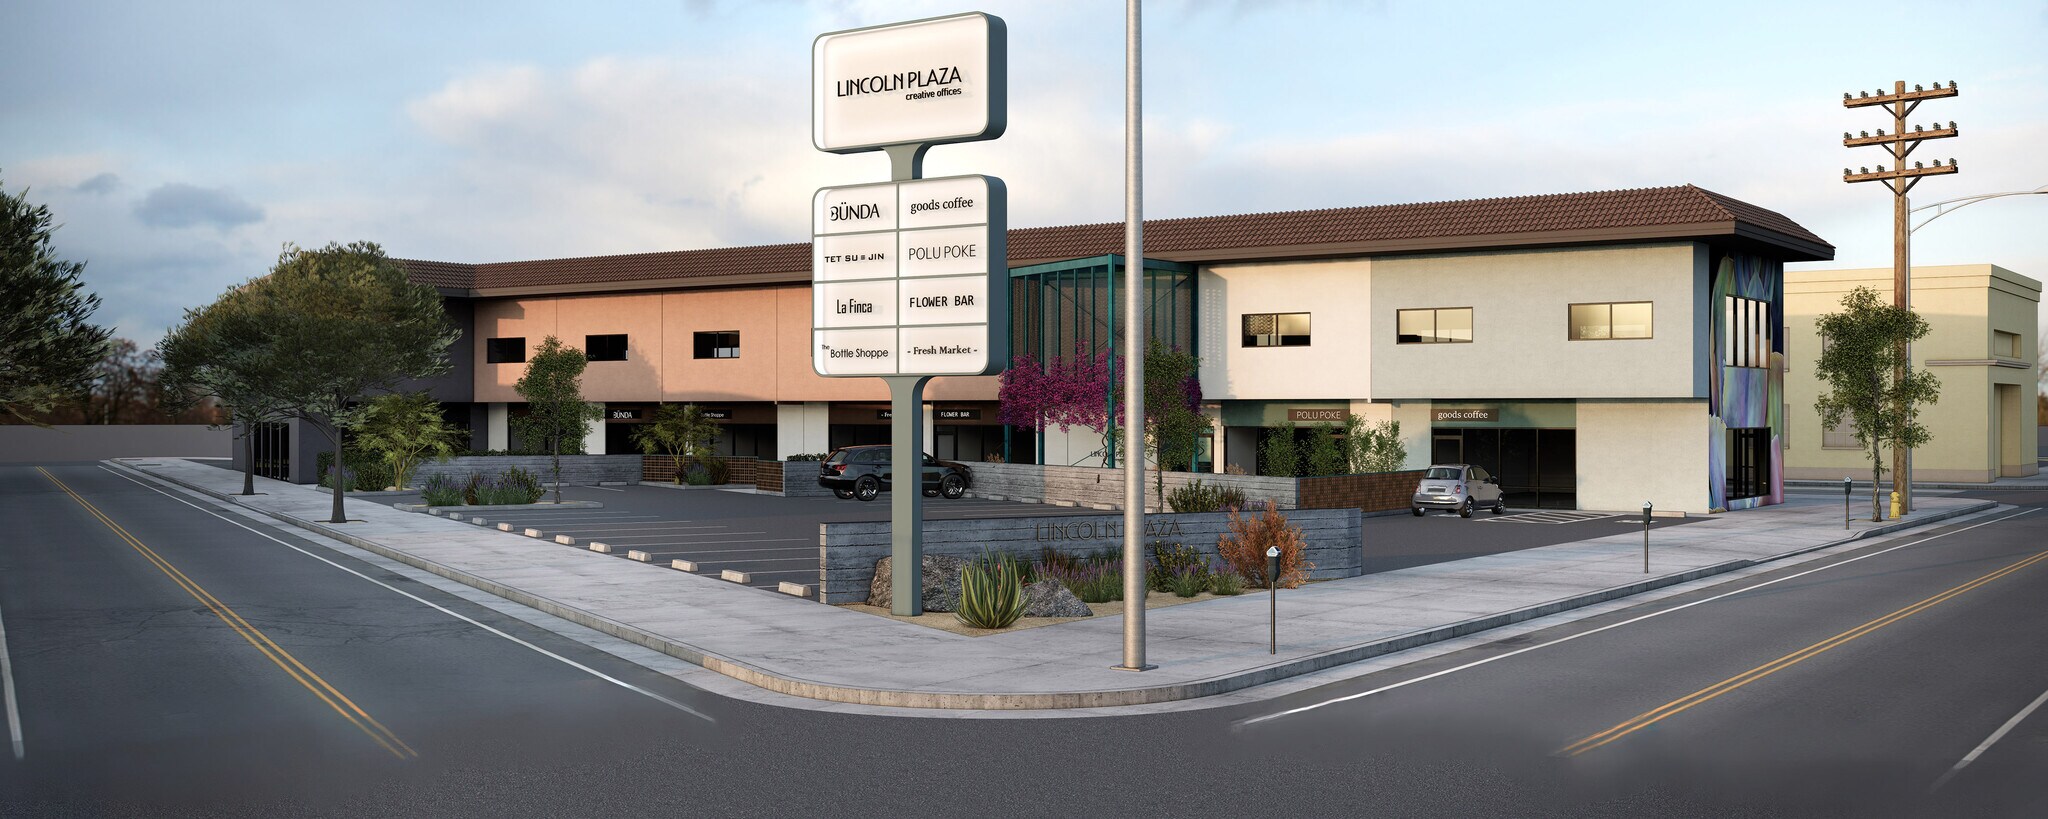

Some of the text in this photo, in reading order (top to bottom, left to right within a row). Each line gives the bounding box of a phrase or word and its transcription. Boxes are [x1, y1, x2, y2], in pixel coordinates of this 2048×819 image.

[837, 66, 962, 97] LINCOLN PLAZA
[905, 87, 962, 101] creative offices
[830, 201, 880, 221] BÜNDA
[910, 196, 974, 215] goods coffee
[824, 253, 885, 263] TET SU JIN
[908, 244, 976, 260] POLU POKE
[836, 298, 873, 314] La Finca
[909, 294, 974, 308] FLOWER BAR
[830, 347, 889, 360] Bottle Shoppe
[913, 345, 971, 355] Fresh Market
[1296, 411, 1341, 420] POLU POKE
[1437, 411, 1488, 420] goods coffee
[1037, 521, 1118, 541] LINCOLN
